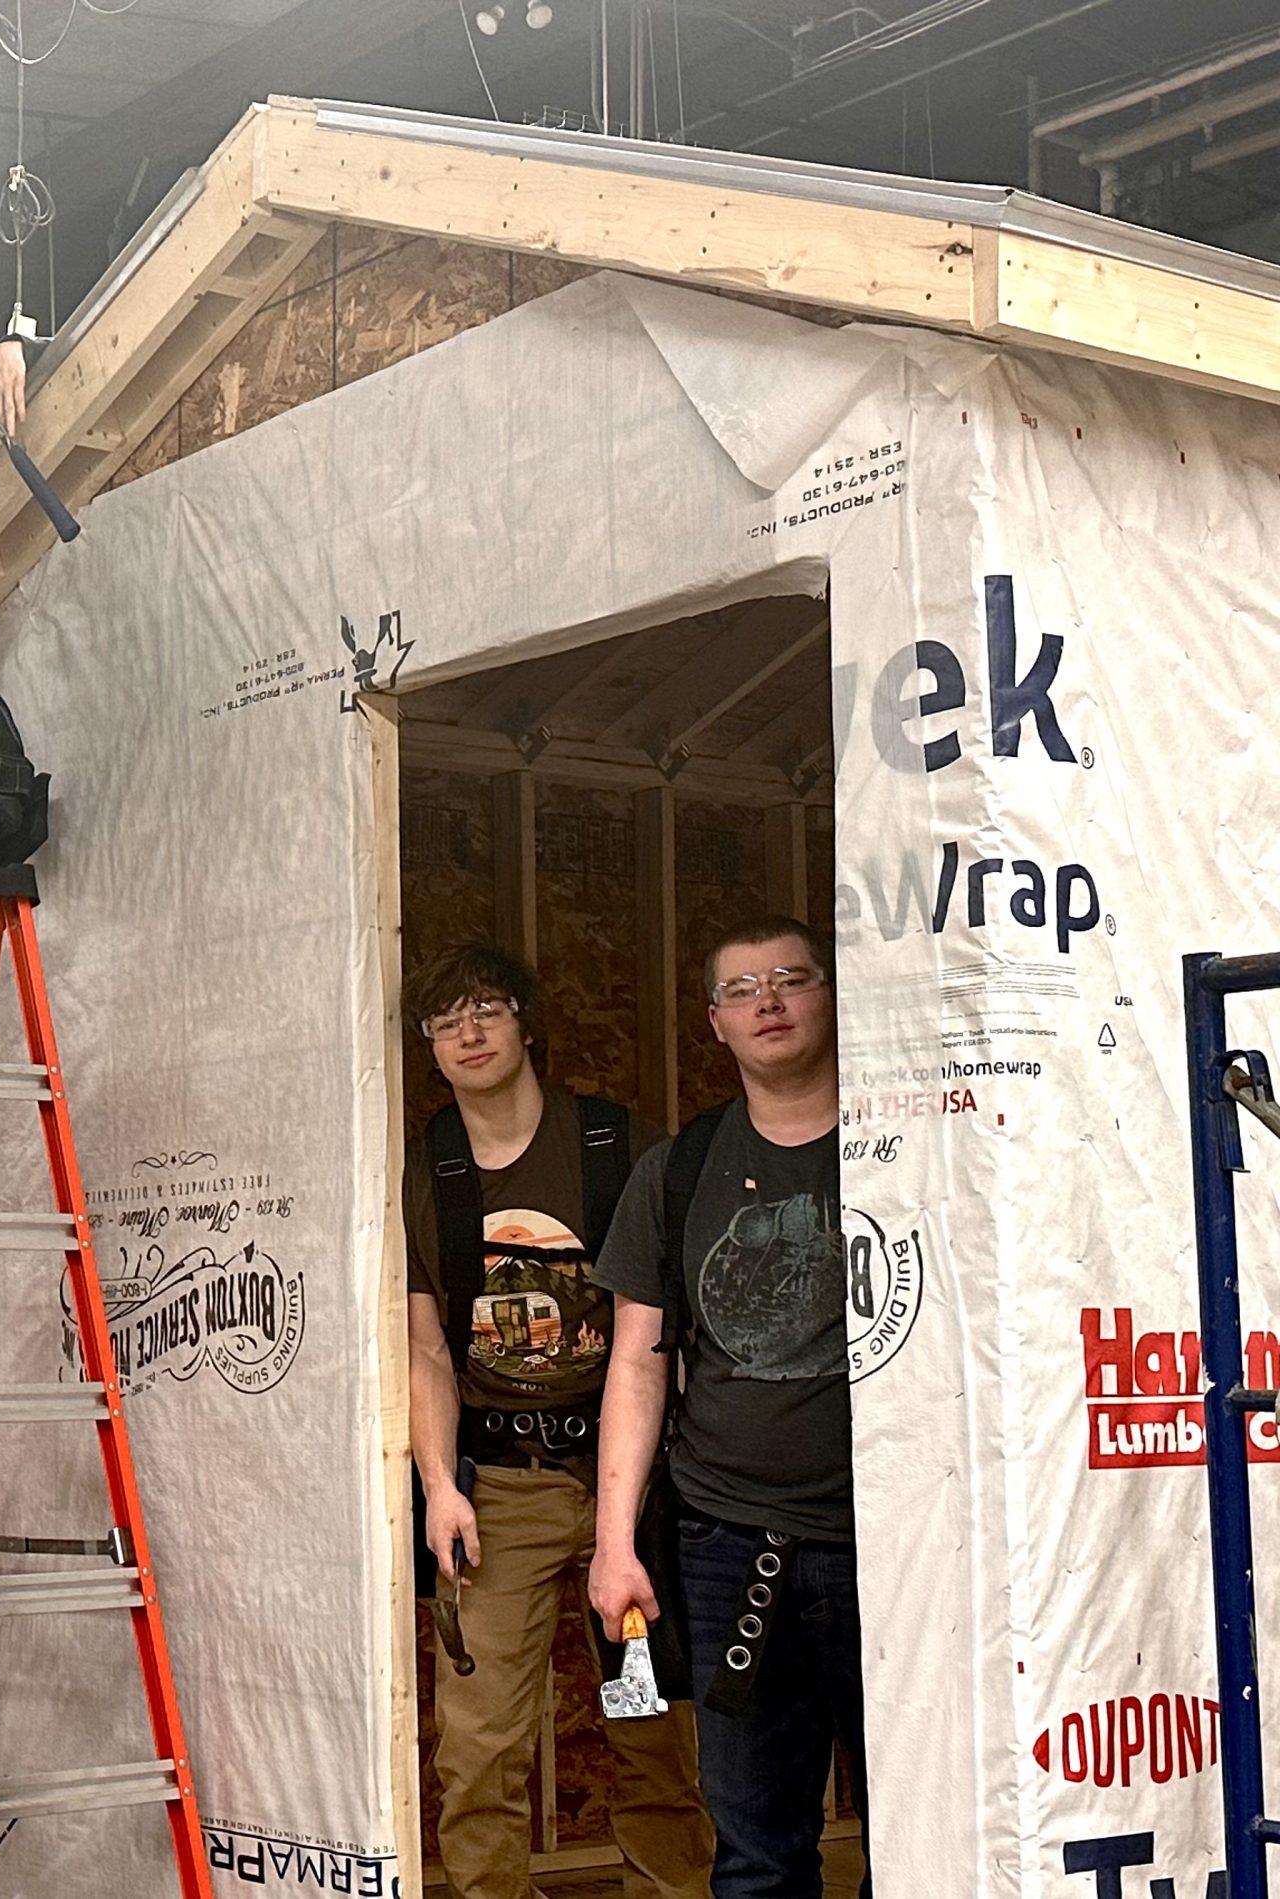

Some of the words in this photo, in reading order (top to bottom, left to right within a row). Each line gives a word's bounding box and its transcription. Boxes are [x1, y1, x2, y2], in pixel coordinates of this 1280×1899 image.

[306, 666, 345, 684] PERMA
[119, 1206, 170, 1239] Maine
[136, 1287, 201, 1370] SERVICE
[204, 1271, 276, 1342] BUXTON
[272, 1279, 300, 1372] BUILDING
[869, 1239, 909, 1356] BUILDING
[214, 1346, 269, 1386] SUPPLIES
[1098, 1409, 1207, 1456] Lumb
[1062, 1693, 1220, 1788] DUPONT
